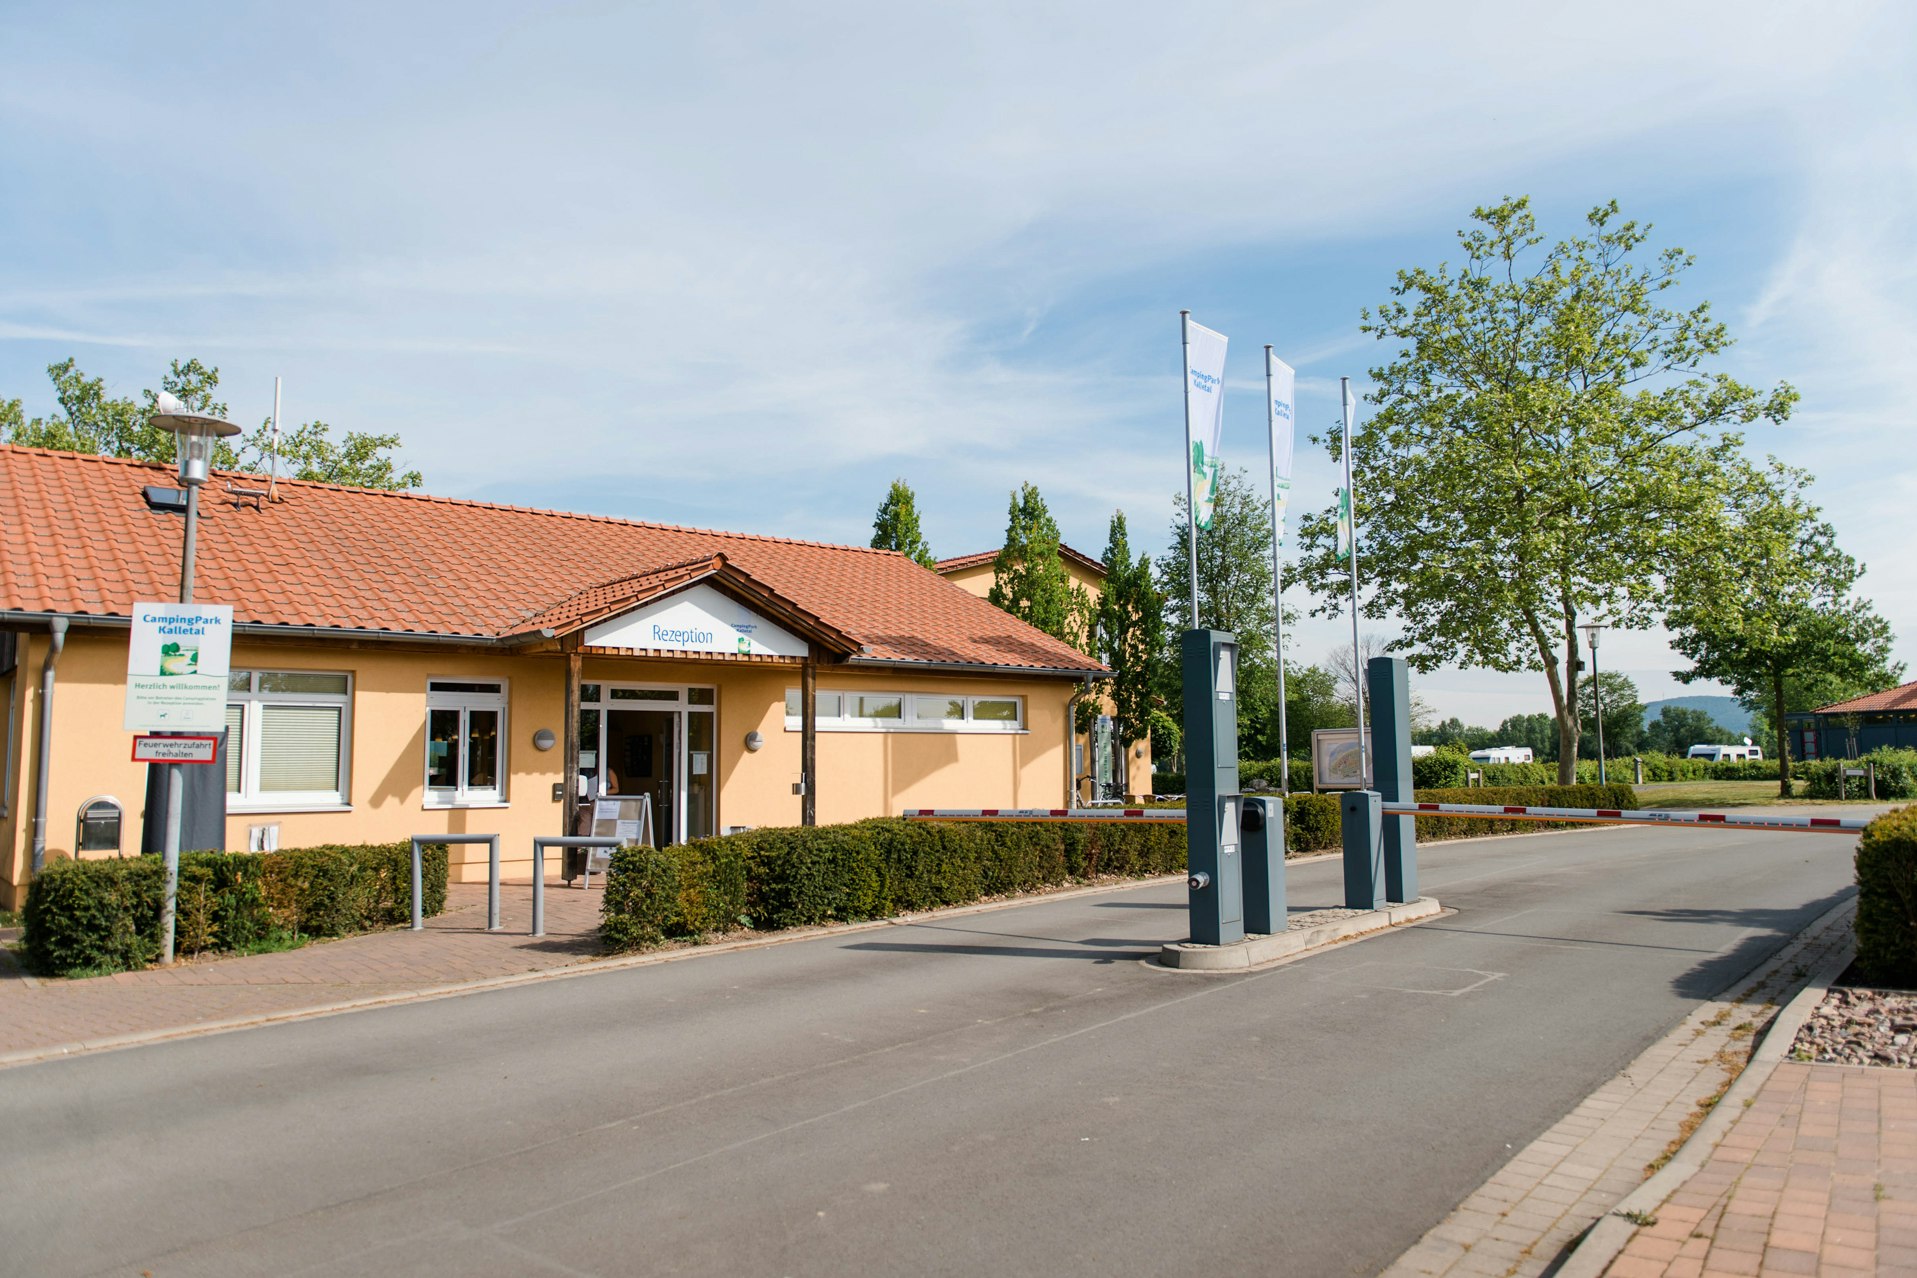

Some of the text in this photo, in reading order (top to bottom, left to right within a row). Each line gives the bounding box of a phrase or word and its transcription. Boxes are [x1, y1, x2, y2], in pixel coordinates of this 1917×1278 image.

[143, 614, 222, 626] CampingPark
[158, 626, 205, 635] Kalletal
[653, 624, 713, 646] Rezeption
[138, 741, 212, 749] Feuerwehrzufahrt
[155, 750, 193, 758] freihalten
